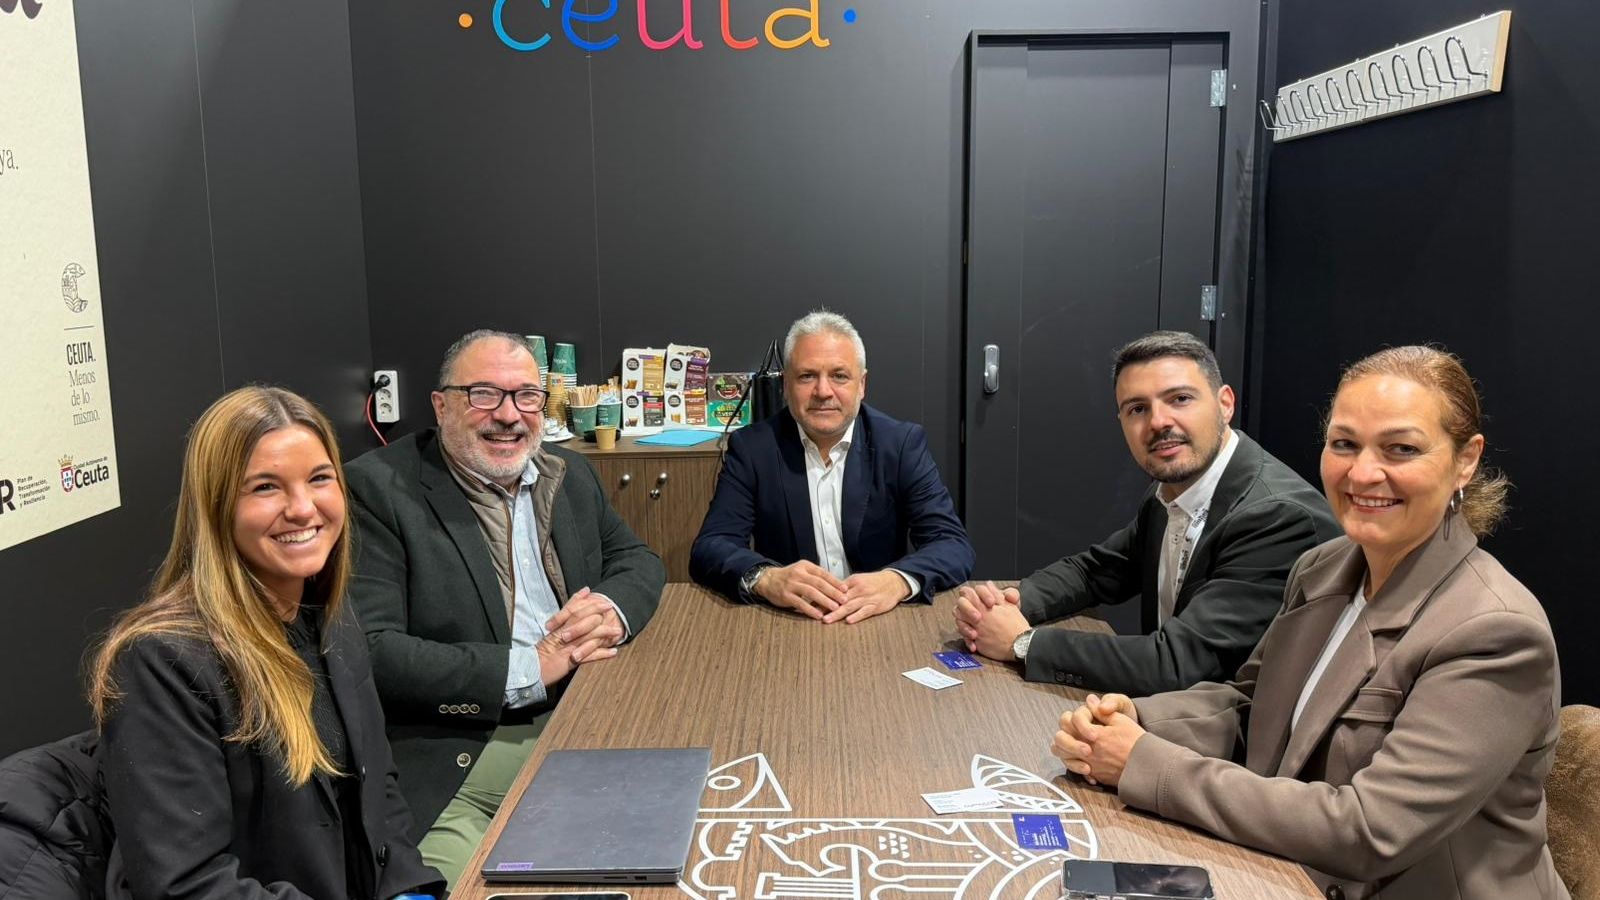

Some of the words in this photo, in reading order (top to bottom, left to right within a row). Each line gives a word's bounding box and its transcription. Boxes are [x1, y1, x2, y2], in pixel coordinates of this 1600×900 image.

[66, 341, 97, 366] CEUTA.
[69, 369, 97, 388] Menos
[71, 390, 81, 407] de
[82, 387, 91, 405] lo
[73, 408, 101, 426] mismo.
[74, 464, 110, 489] Ceuta
